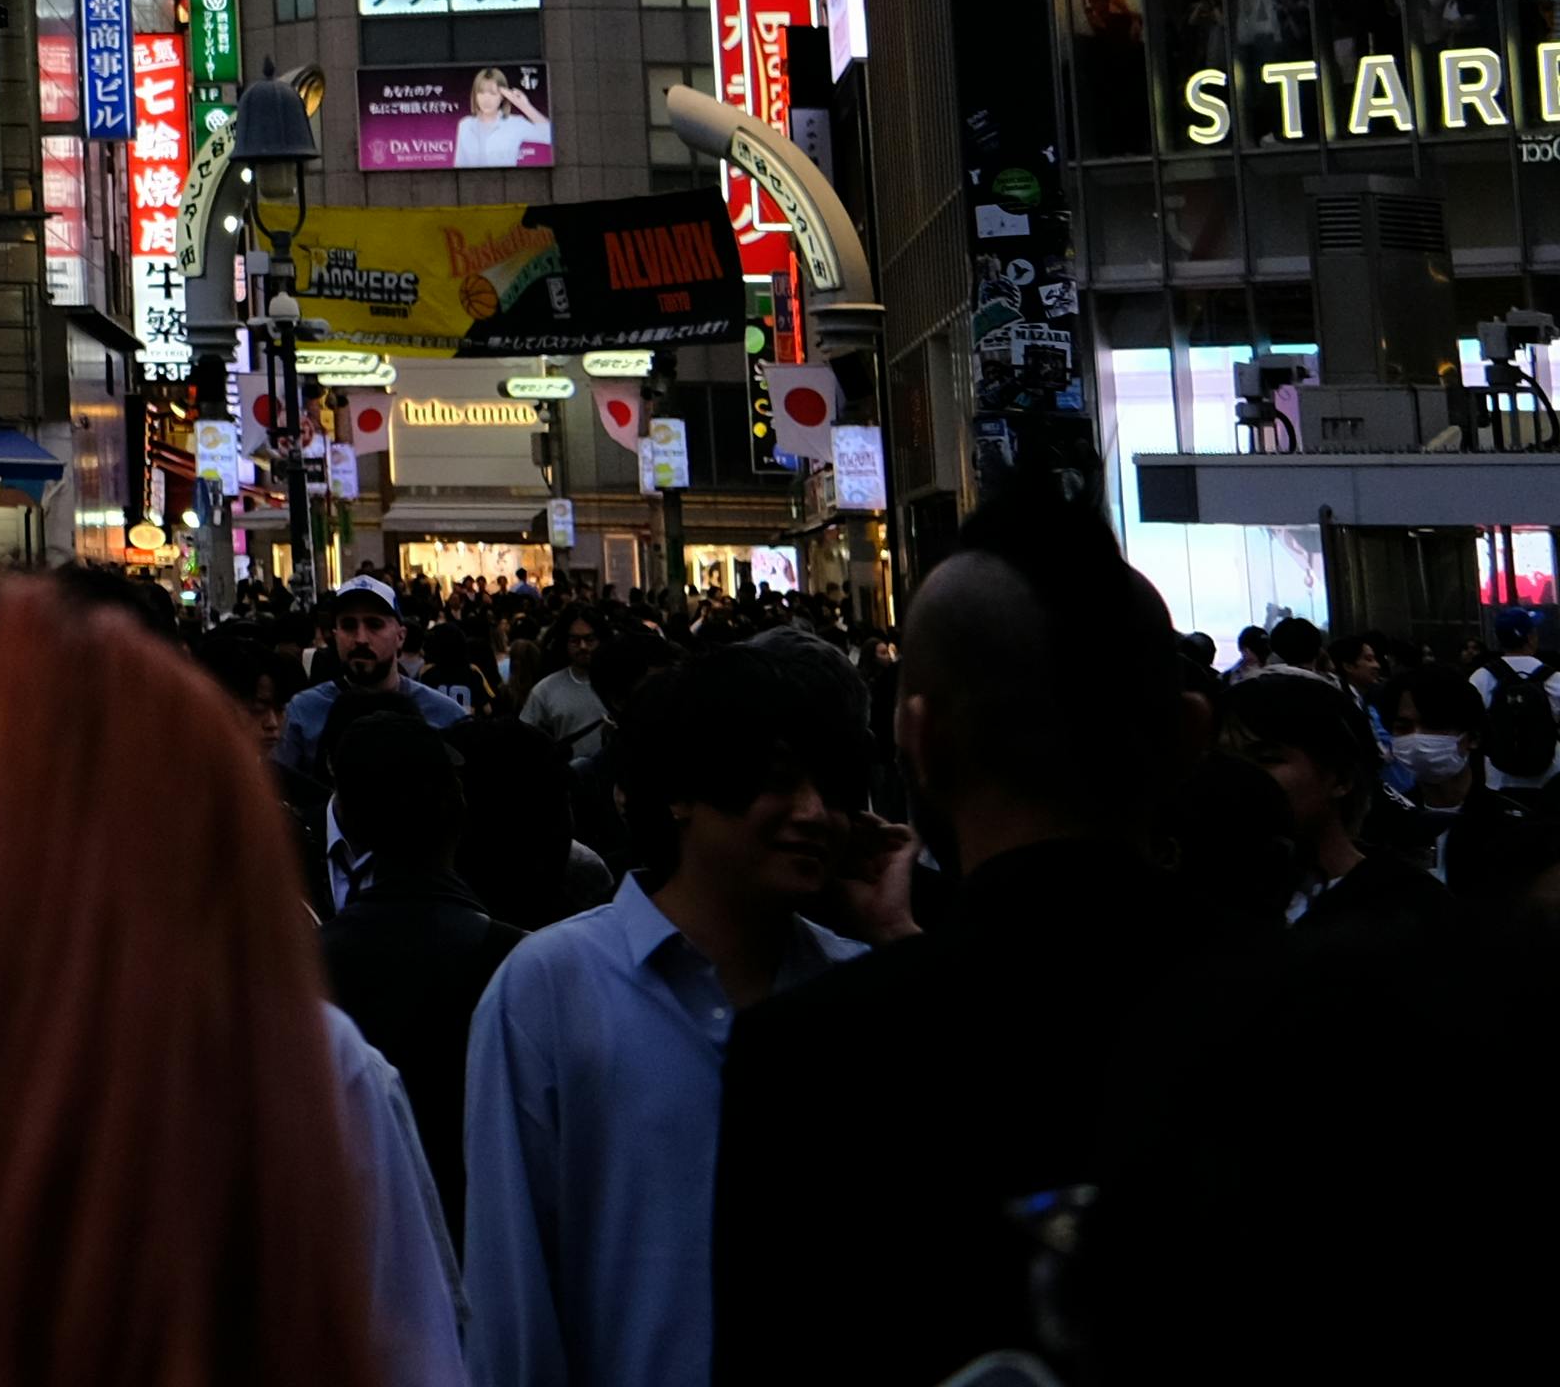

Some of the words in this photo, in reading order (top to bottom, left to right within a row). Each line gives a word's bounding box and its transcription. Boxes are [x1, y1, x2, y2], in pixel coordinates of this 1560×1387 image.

[132, 72, 182, 252] 七輪焼肉
[390, 140, 411, 154] DA
[412, 138, 454, 153] VINCI
[328, 248, 356, 270] SUN
[602, 221, 725, 290] ALVARK
